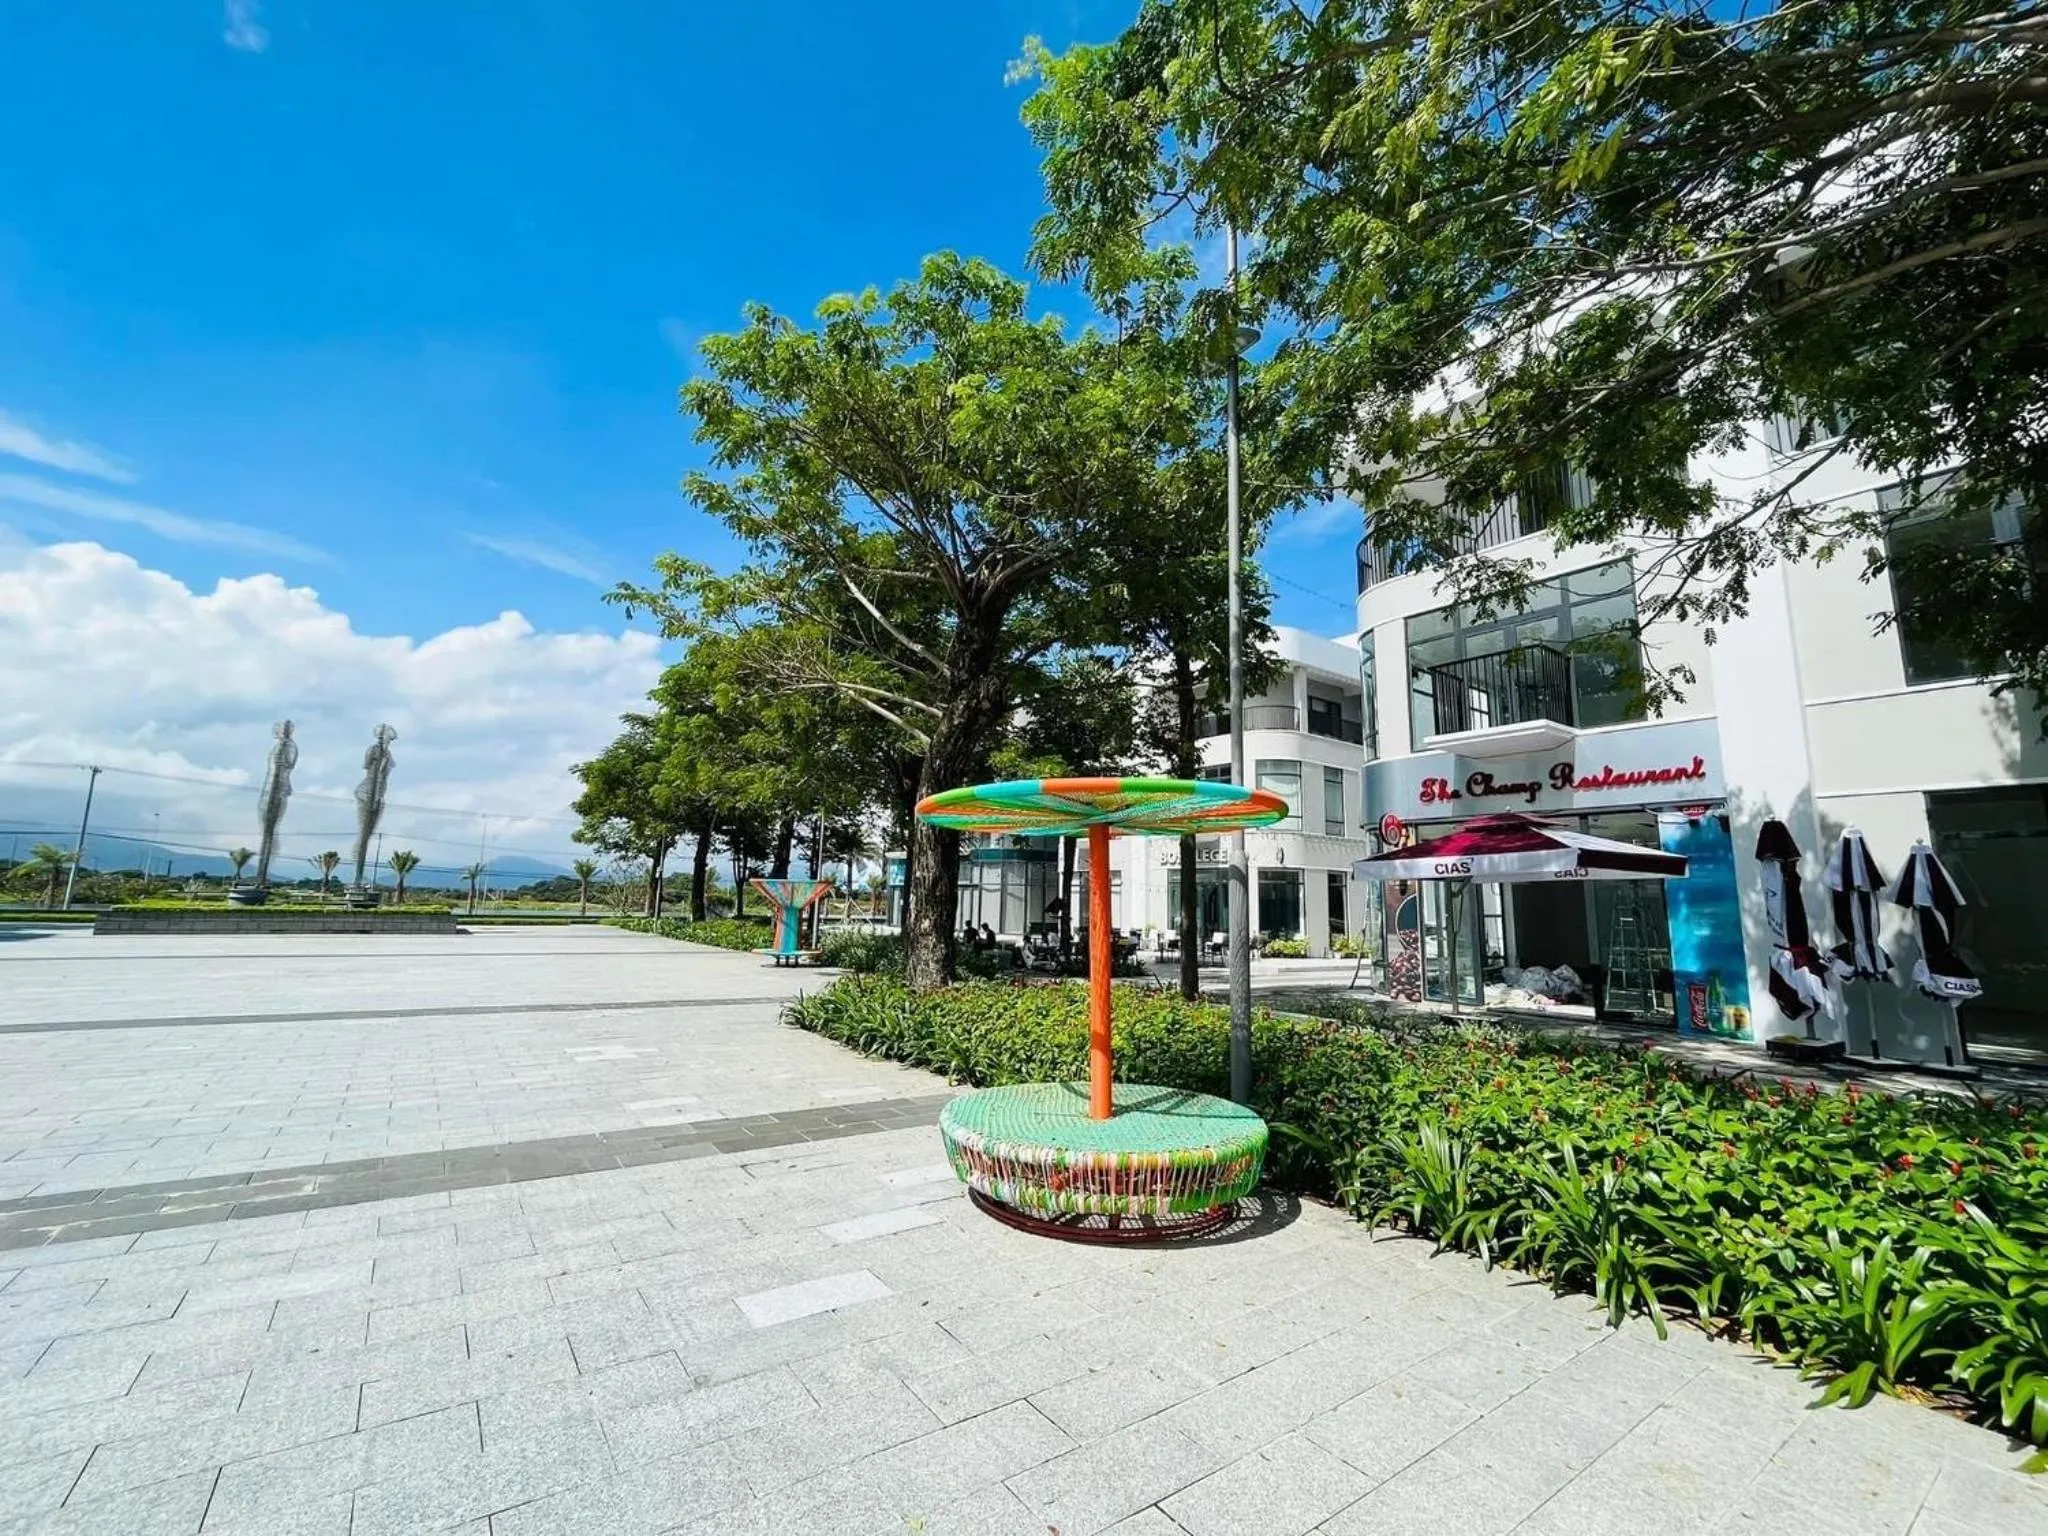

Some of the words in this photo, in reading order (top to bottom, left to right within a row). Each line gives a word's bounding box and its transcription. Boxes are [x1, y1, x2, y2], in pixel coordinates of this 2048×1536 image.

[1420, 778, 1462, 803] The
[1465, 772, 1542, 803] Champ
[1549, 756, 1706, 791] Restaurant
[1434, 862, 1471, 875] CIAS
